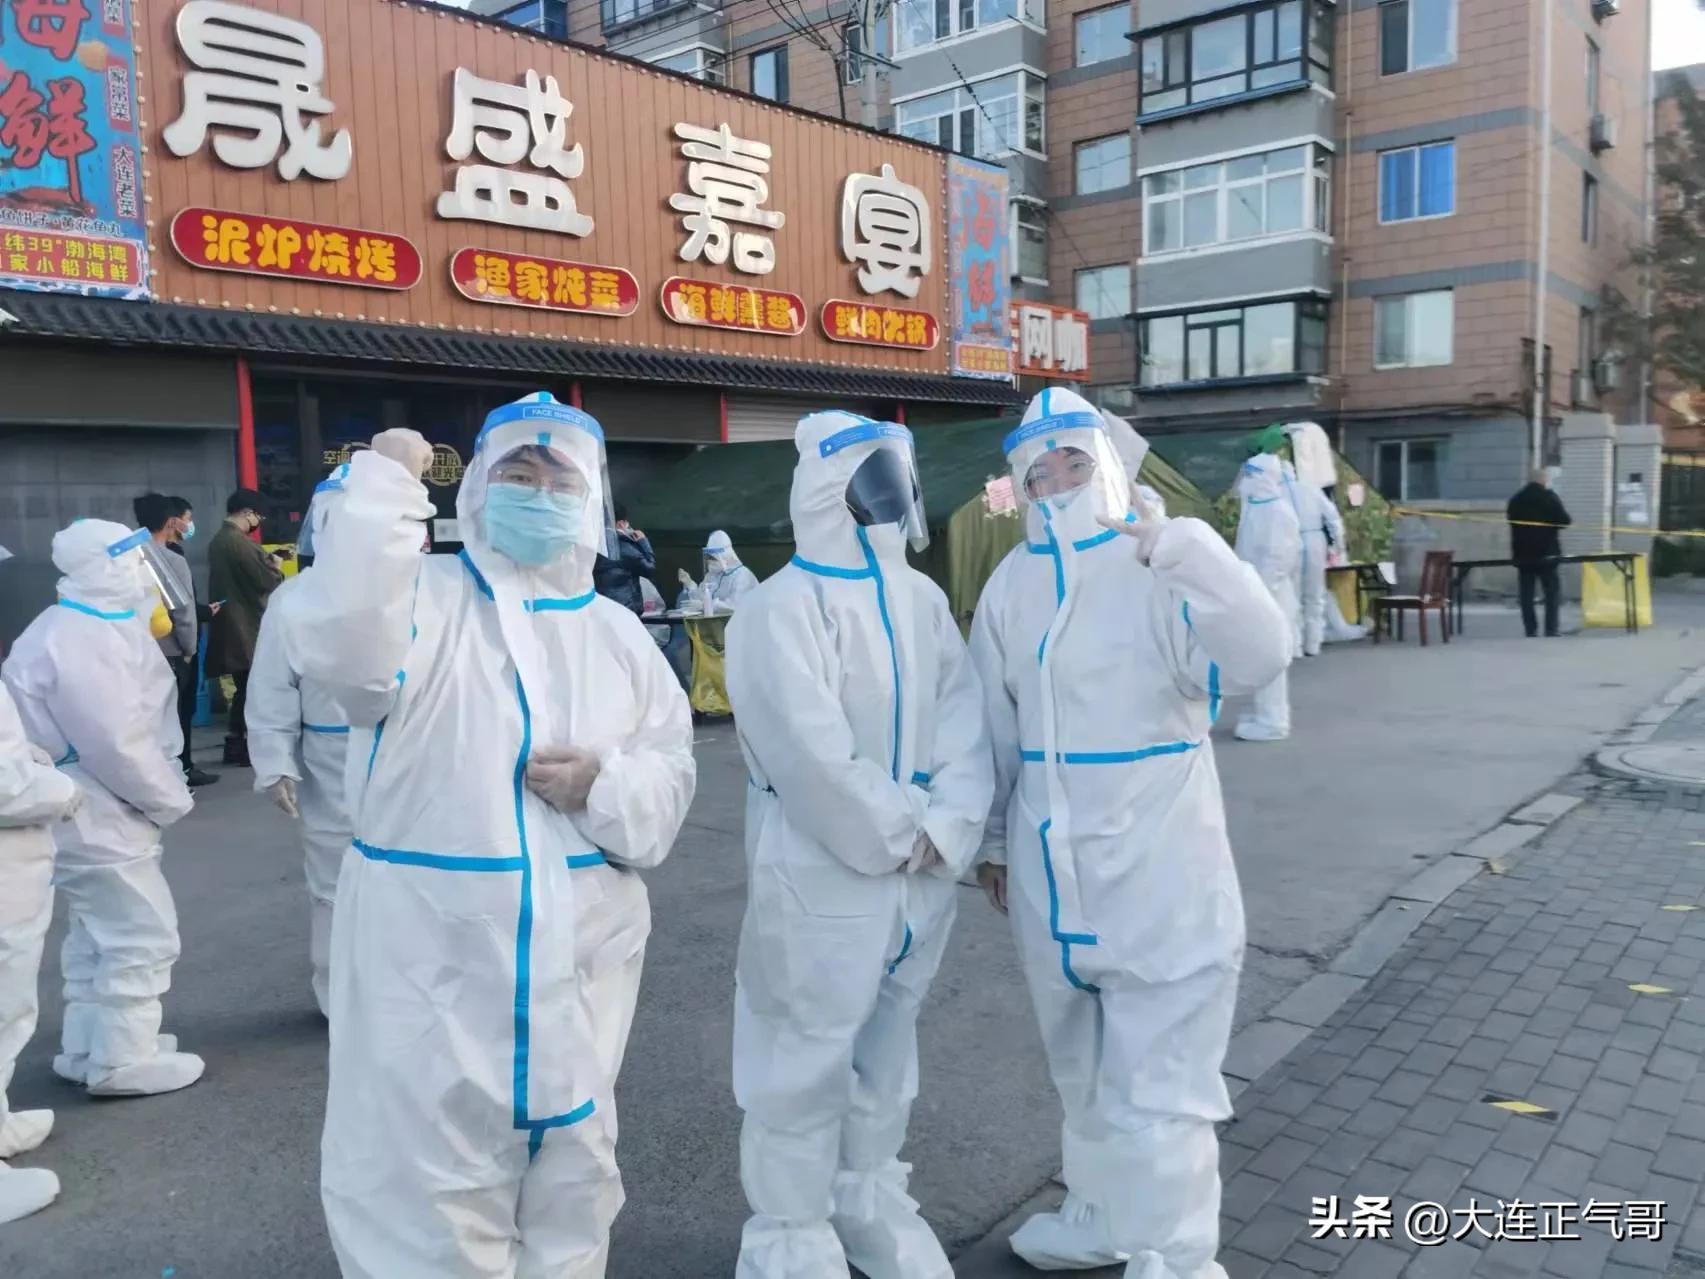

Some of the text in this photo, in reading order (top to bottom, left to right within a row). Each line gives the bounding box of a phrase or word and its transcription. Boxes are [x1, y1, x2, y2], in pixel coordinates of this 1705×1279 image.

[163, 1, 931, 298] 晟盛嘉宴
[202, 215, 397, 282] 泥炉烧烤
